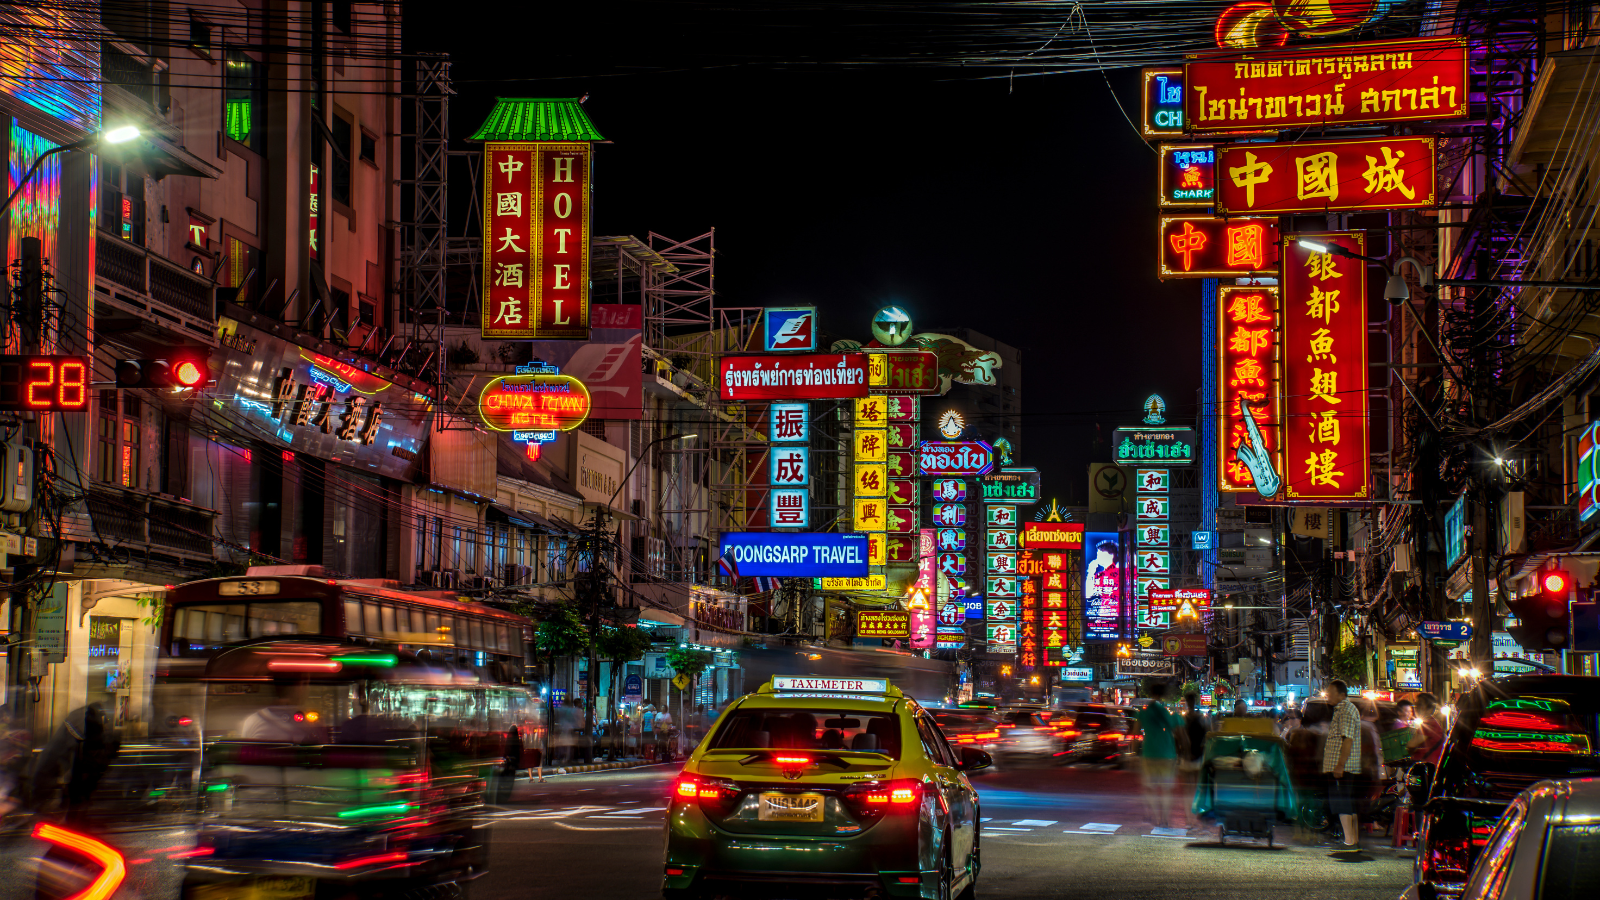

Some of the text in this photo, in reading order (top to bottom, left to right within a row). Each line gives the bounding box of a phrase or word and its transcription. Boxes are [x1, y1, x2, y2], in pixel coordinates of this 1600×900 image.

[1194, 76, 1457, 122] ไชน่าทาวน์ สกาล่า
[1229, 146, 1416, 208] 中國城
[493, 154, 526, 326] 中國大酒店
[552, 157, 575, 325] HOTEL
[28, 361, 86, 407] 28
[725, 355, 864, 396] รุ่งทรัพย์การท่องเที่ยว
[1303, 248, 1344, 489] 銀都魚翅酒樓
[487, 394, 585, 411] CHINA TOWN
[511, 412, 559, 426] HOTEL
[775, 409, 804, 524] 振成豐
[812, 545, 863, 564] TRAVEL
[940, 481, 959, 624] 馬利興大行
[238, 581, 260, 594] 53
[994, 509, 1010, 643] 和成興大金行
[1460, 625, 1468, 636] 2
[790, 678, 864, 690] TAXI-METER
